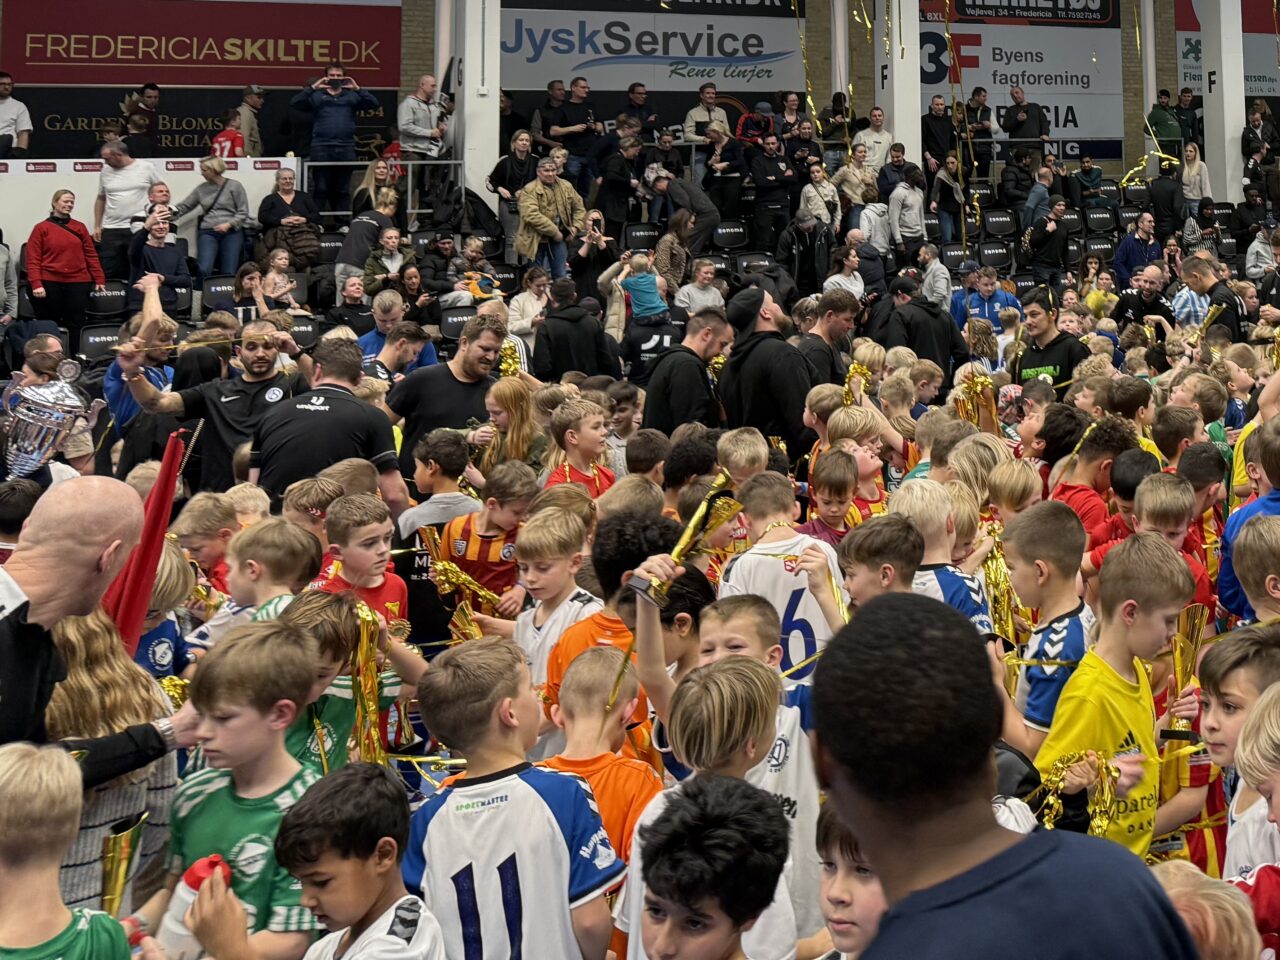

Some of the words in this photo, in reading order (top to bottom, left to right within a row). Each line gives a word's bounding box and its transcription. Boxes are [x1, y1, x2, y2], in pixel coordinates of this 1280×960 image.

[965, 7, 996, 17] Vejlevej
[997, 8, 1008, 16] 34
[1015, 9, 1053, 18] Fredericia
[25, 33, 381, 64] FREDERICIASKILTE.DK
[500, 18, 764, 63] JyskService
[920, 31, 982, 85] 3F
[992, 46, 1044, 66] Byens
[667, 60, 720, 80] Rene
[722, 62, 774, 82] linjer
[881, 64, 889, 89] F
[992, 69, 1091, 89] fagforening
[1208, 71, 1216, 93] F
[780, 587, 817, 681] 6
[450, 851, 523, 960] 11
